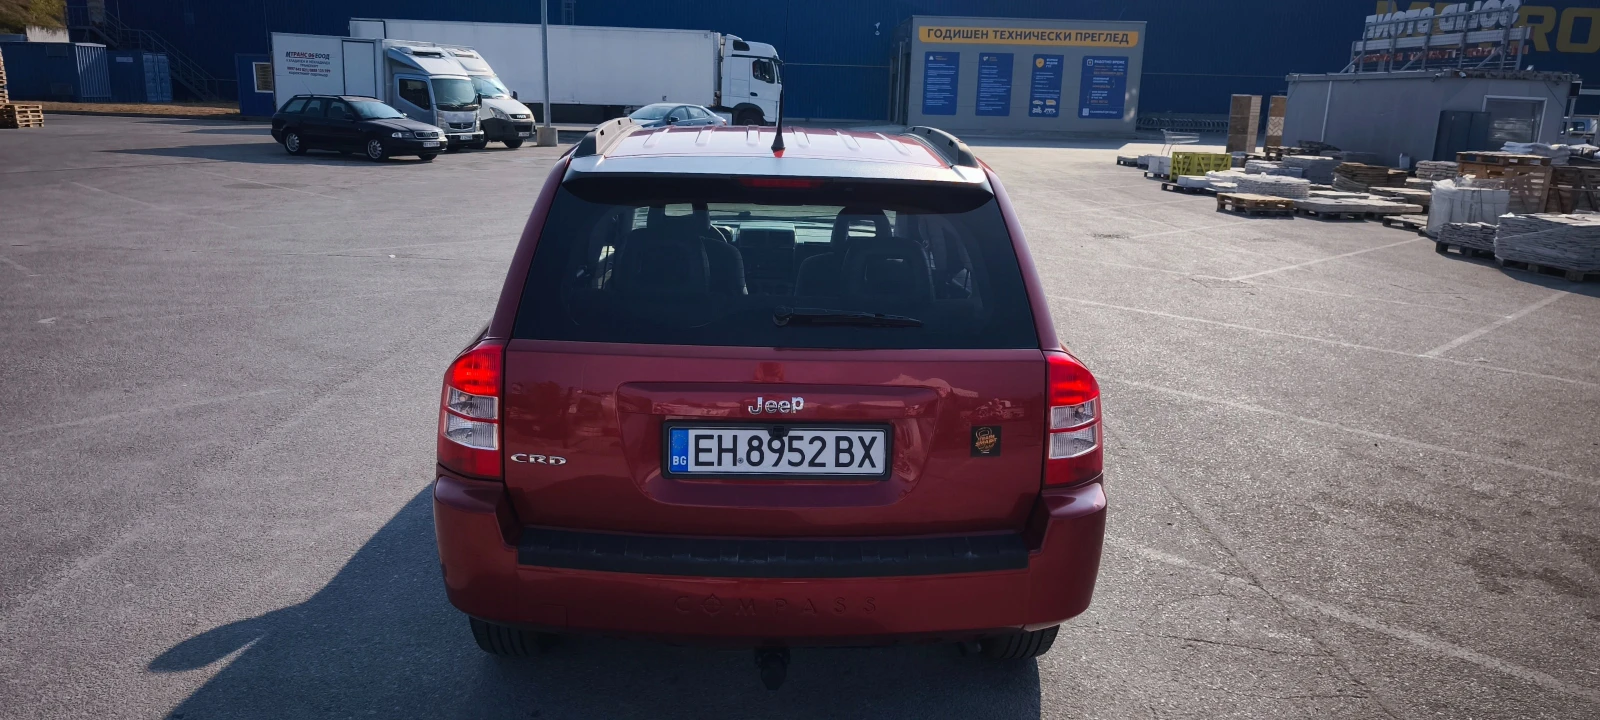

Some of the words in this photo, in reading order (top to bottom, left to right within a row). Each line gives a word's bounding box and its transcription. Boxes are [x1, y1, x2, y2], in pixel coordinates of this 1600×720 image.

[927, 28, 989, 40] ГОДИШЕН
[992, 29, 1072, 42] ТЕХНИЧЕСКИ
[1075, 32, 1129, 45] ПРЕГЛЕД
[748, 397, 804, 414] Jeep
[511, 453, 567, 465] CRD
[694, 434, 738, 467] EH
[746, 435, 827, 467] 8952
[834, 436, 878, 468] BX
[672, 456, 687, 465] BG
[673, 593, 877, 617] COMPASS
